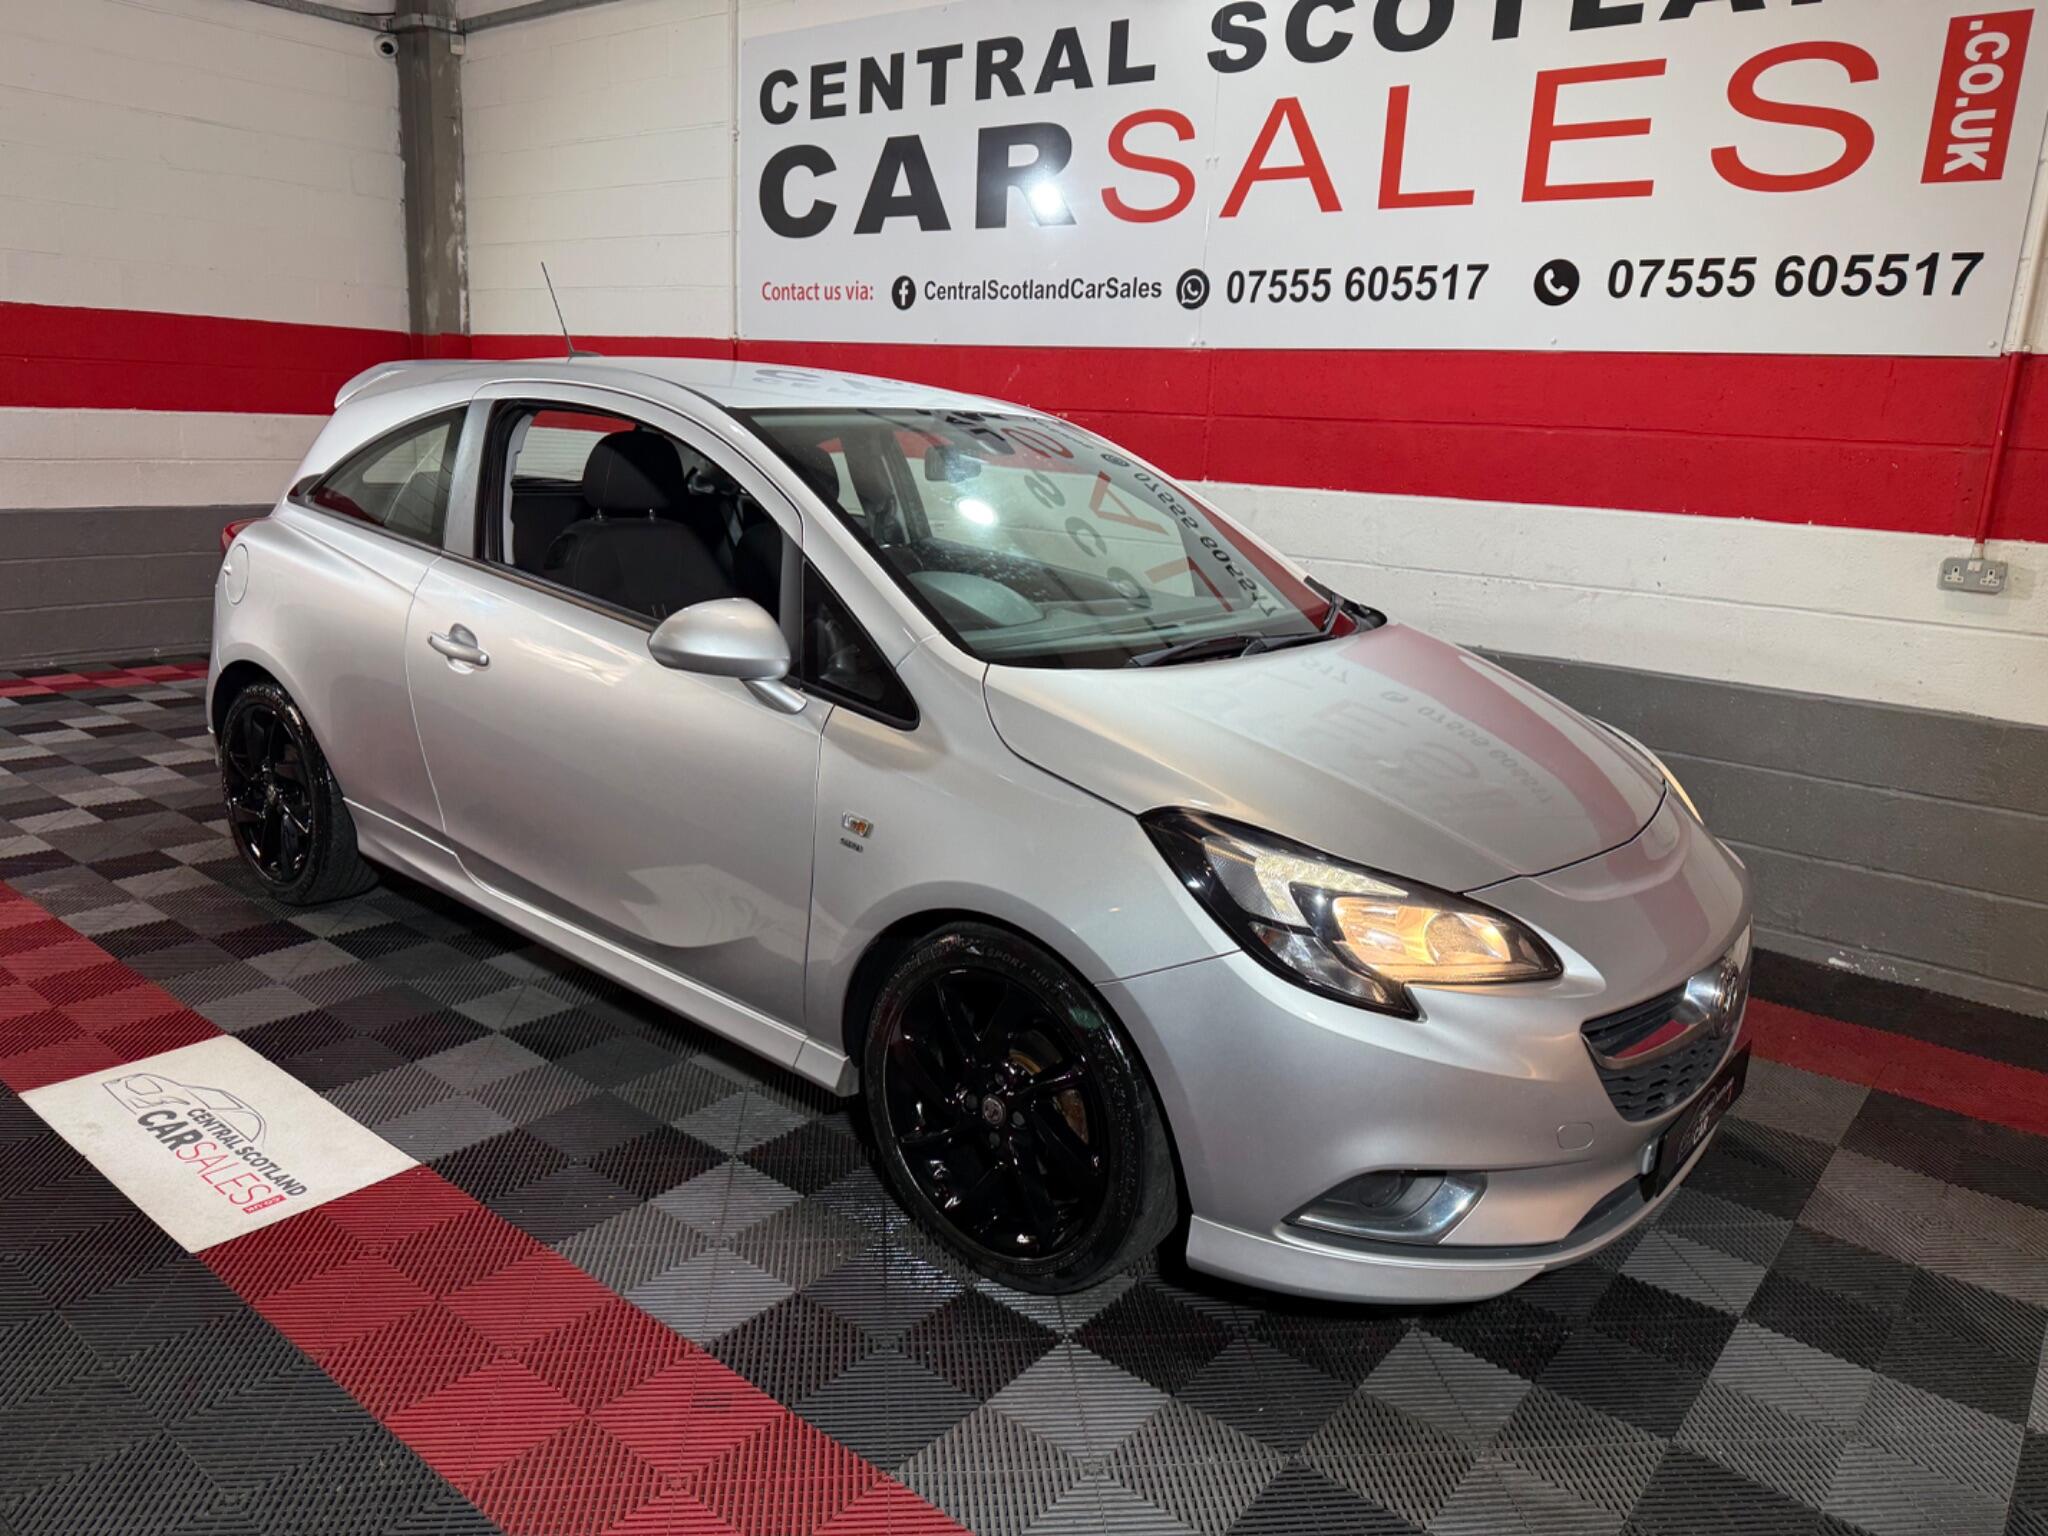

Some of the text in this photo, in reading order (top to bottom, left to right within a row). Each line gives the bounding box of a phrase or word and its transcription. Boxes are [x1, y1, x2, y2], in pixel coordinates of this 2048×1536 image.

[759, 18, 1157, 125] CENTRAL
[761, 281, 820, 301] Contact
[824, 285, 841, 301] us
[845, 280, 874, 301] via:
[924, 277, 1162, 301] CentralScotlandCarSales
[1226, 268, 1332, 304] 07555
[1344, 263, 1490, 302] 605517
[1607, 256, 1758, 299] 07555
[1774, 251, 1985, 298] 605517
[187, 1107, 245, 1149] CENTRAL
[235, 1146, 308, 1197] SCOTLAND
